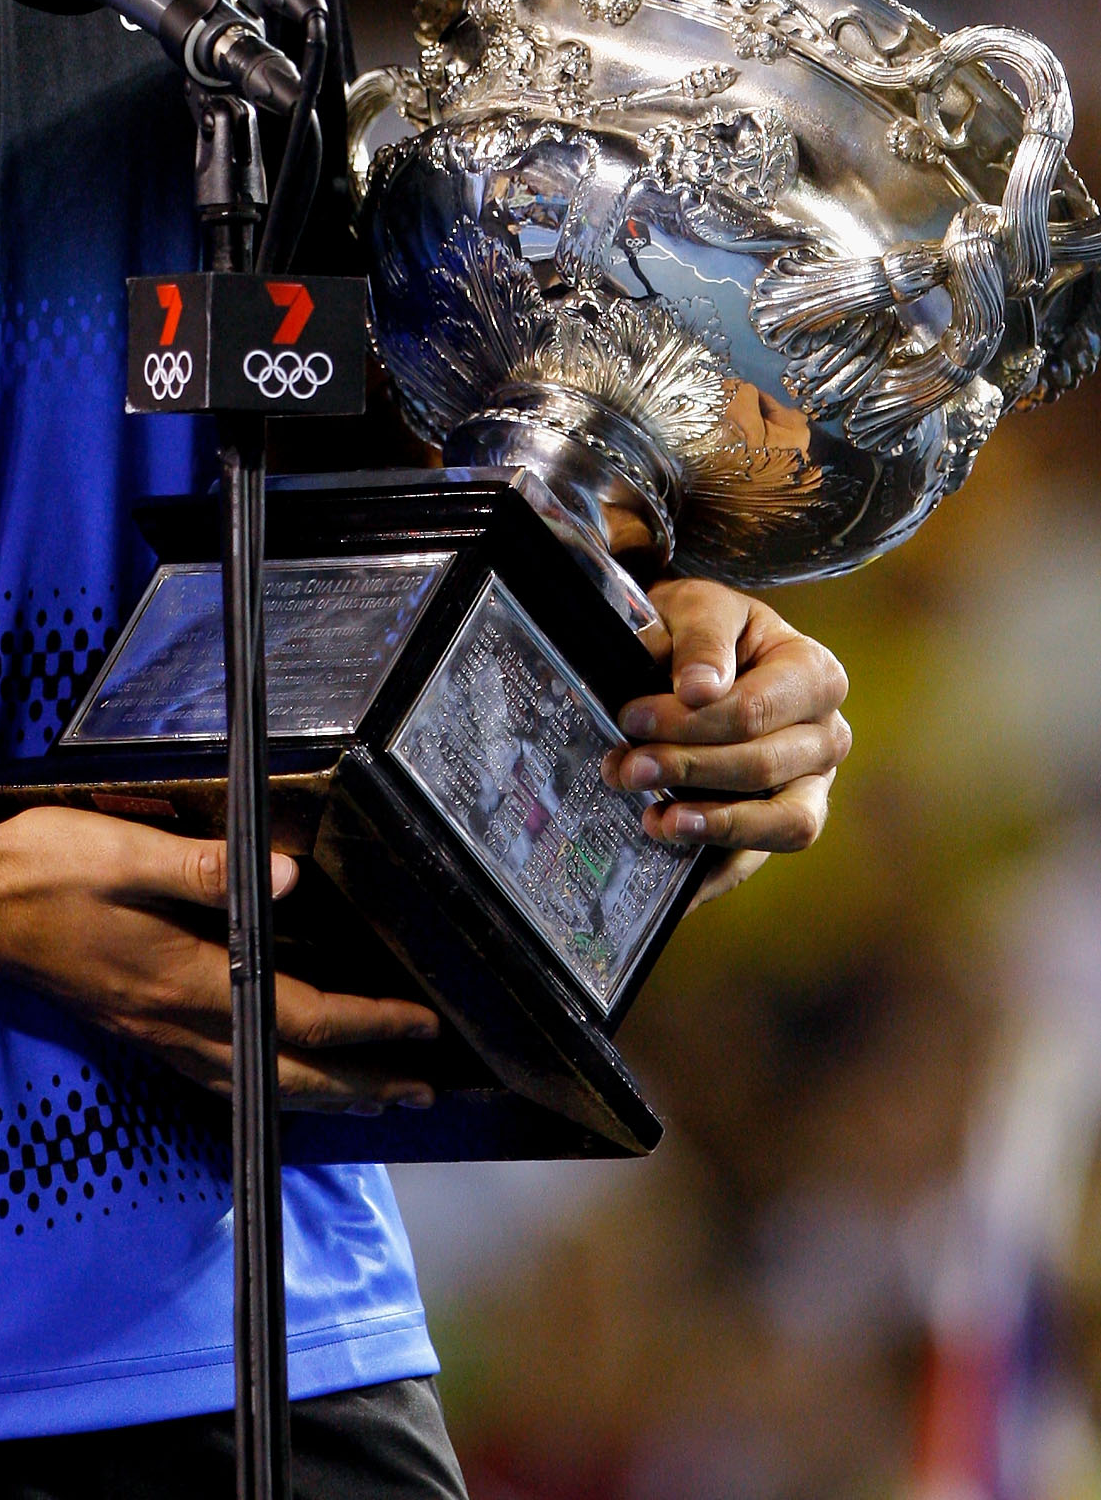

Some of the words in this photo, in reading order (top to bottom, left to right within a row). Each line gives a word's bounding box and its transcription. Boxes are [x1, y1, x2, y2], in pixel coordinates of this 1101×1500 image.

[156, 284, 183, 346] 7
[265, 282, 315, 345] 7
[392, 575, 424, 592] CUP
